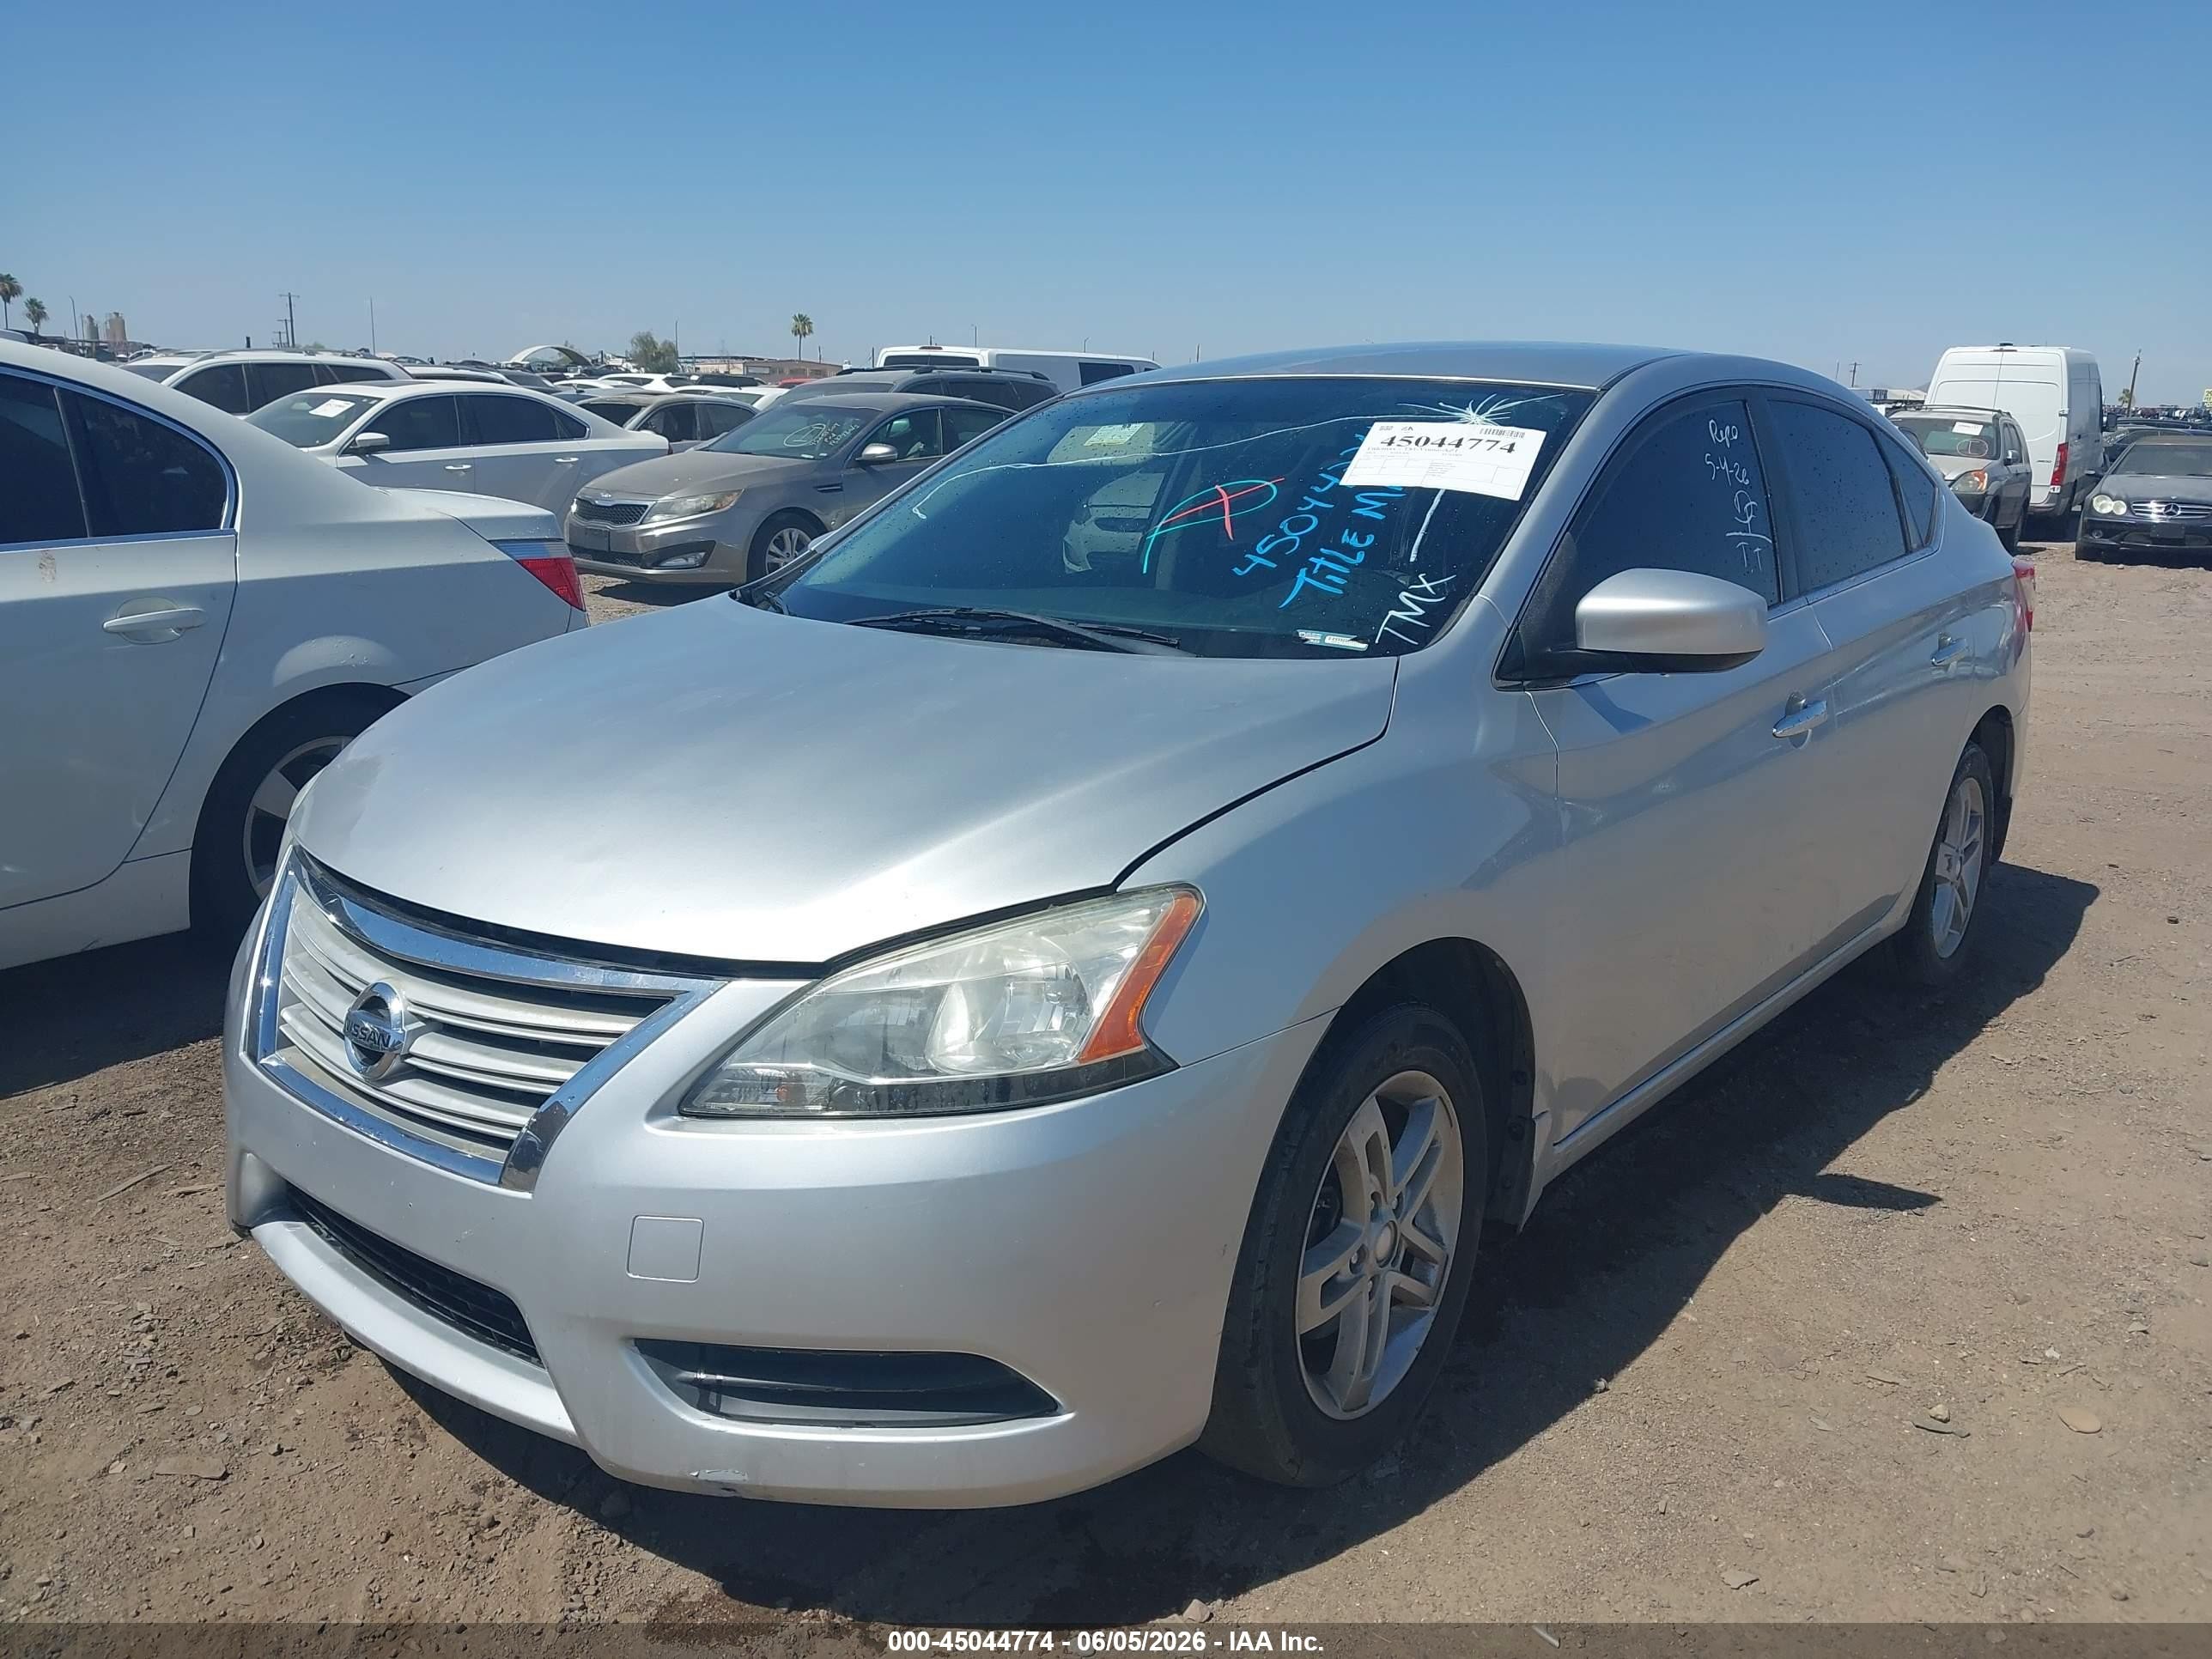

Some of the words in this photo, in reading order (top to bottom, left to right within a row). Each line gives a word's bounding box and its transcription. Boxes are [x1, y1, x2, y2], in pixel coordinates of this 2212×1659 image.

[1380, 434, 1516, 454] 45044774
[1708, 419, 1739, 448] Repo
[1375, 573, 1457, 646] TMX
[345, 1019, 392, 1048] NISSAN
